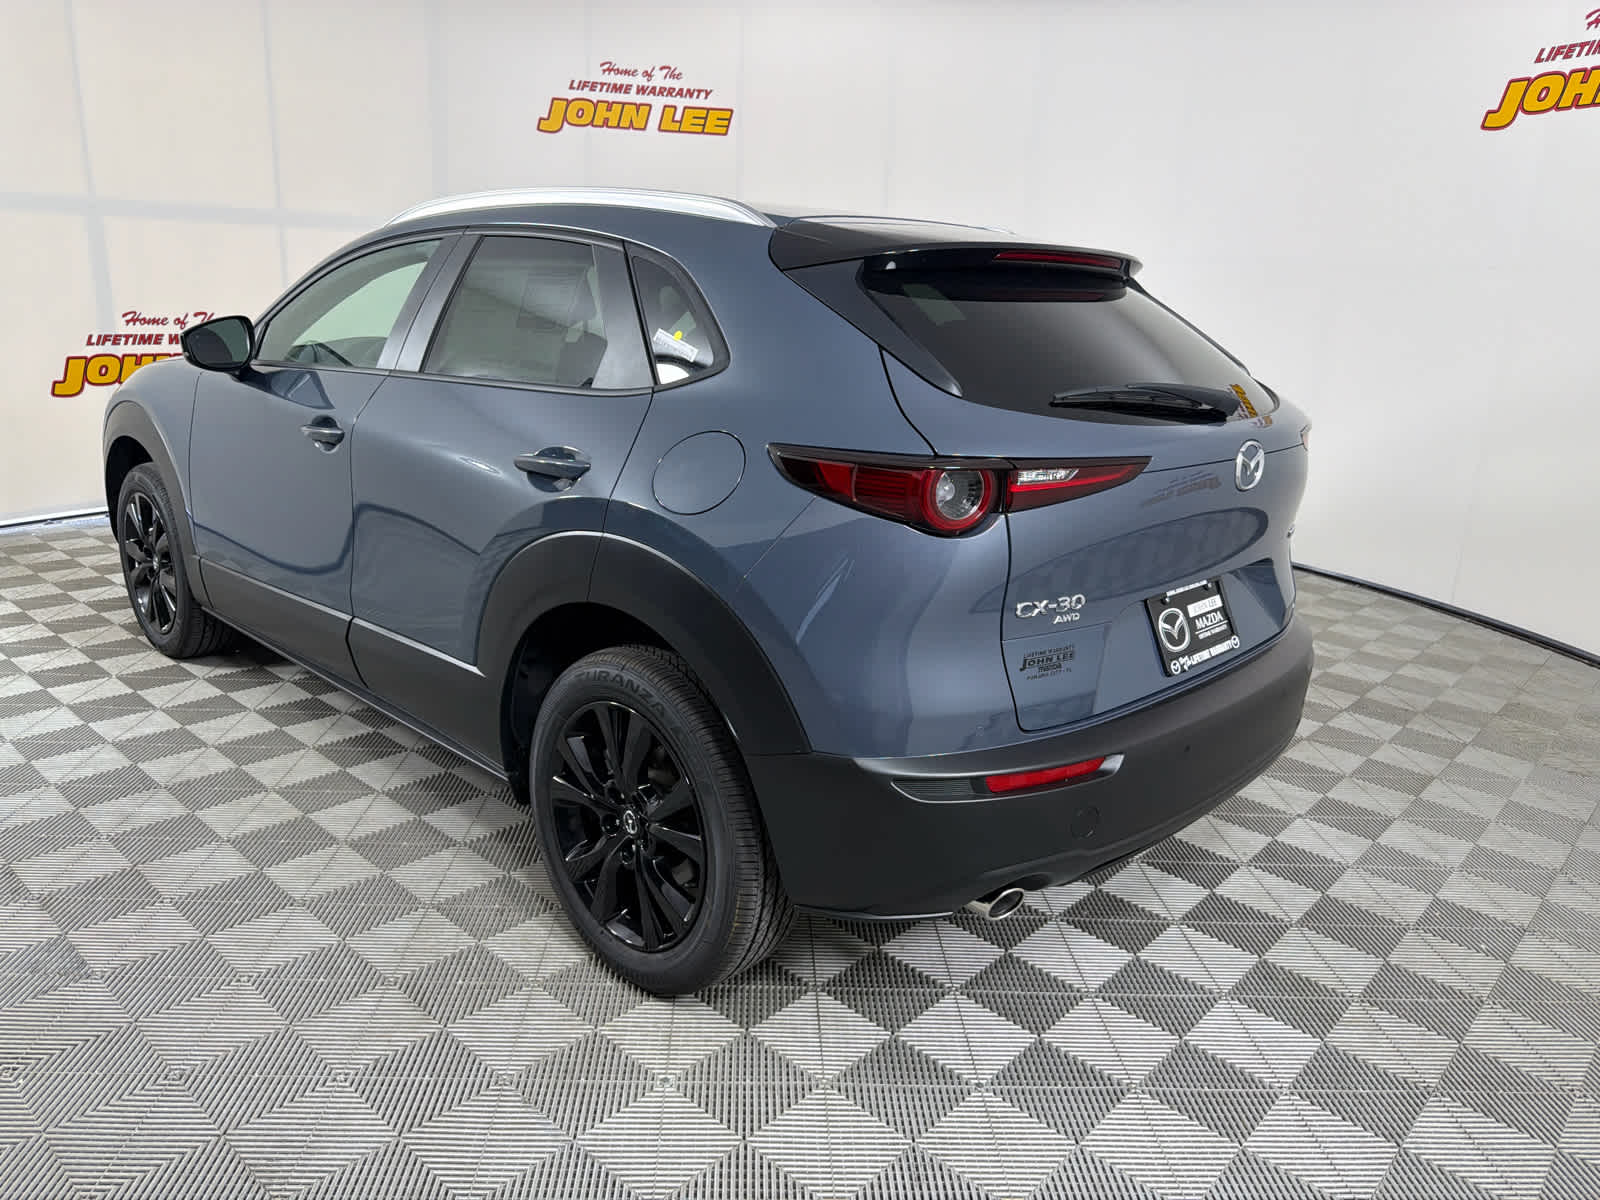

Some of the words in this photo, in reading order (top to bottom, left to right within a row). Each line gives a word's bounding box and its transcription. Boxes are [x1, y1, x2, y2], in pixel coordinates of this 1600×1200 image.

[600, 61, 639, 77] Home
[641, 67, 655, 82] of
[659, 65, 683, 80] The
[569, 80, 632, 94] LIFETIME
[636, 85, 713, 100] WARRANTY
[537, 97, 652, 133] JOHN
[658, 105, 734, 136] LEE
[122, 311, 169, 326] Home
[174, 313, 188, 329] of
[86, 333, 164, 346] LIFETIME
[51, 353, 183, 397] JOH
[1015, 594, 1086, 618] CX-30
[1053, 612, 1081, 625] AWD
[1194, 611, 1224, 630] MAZDA
